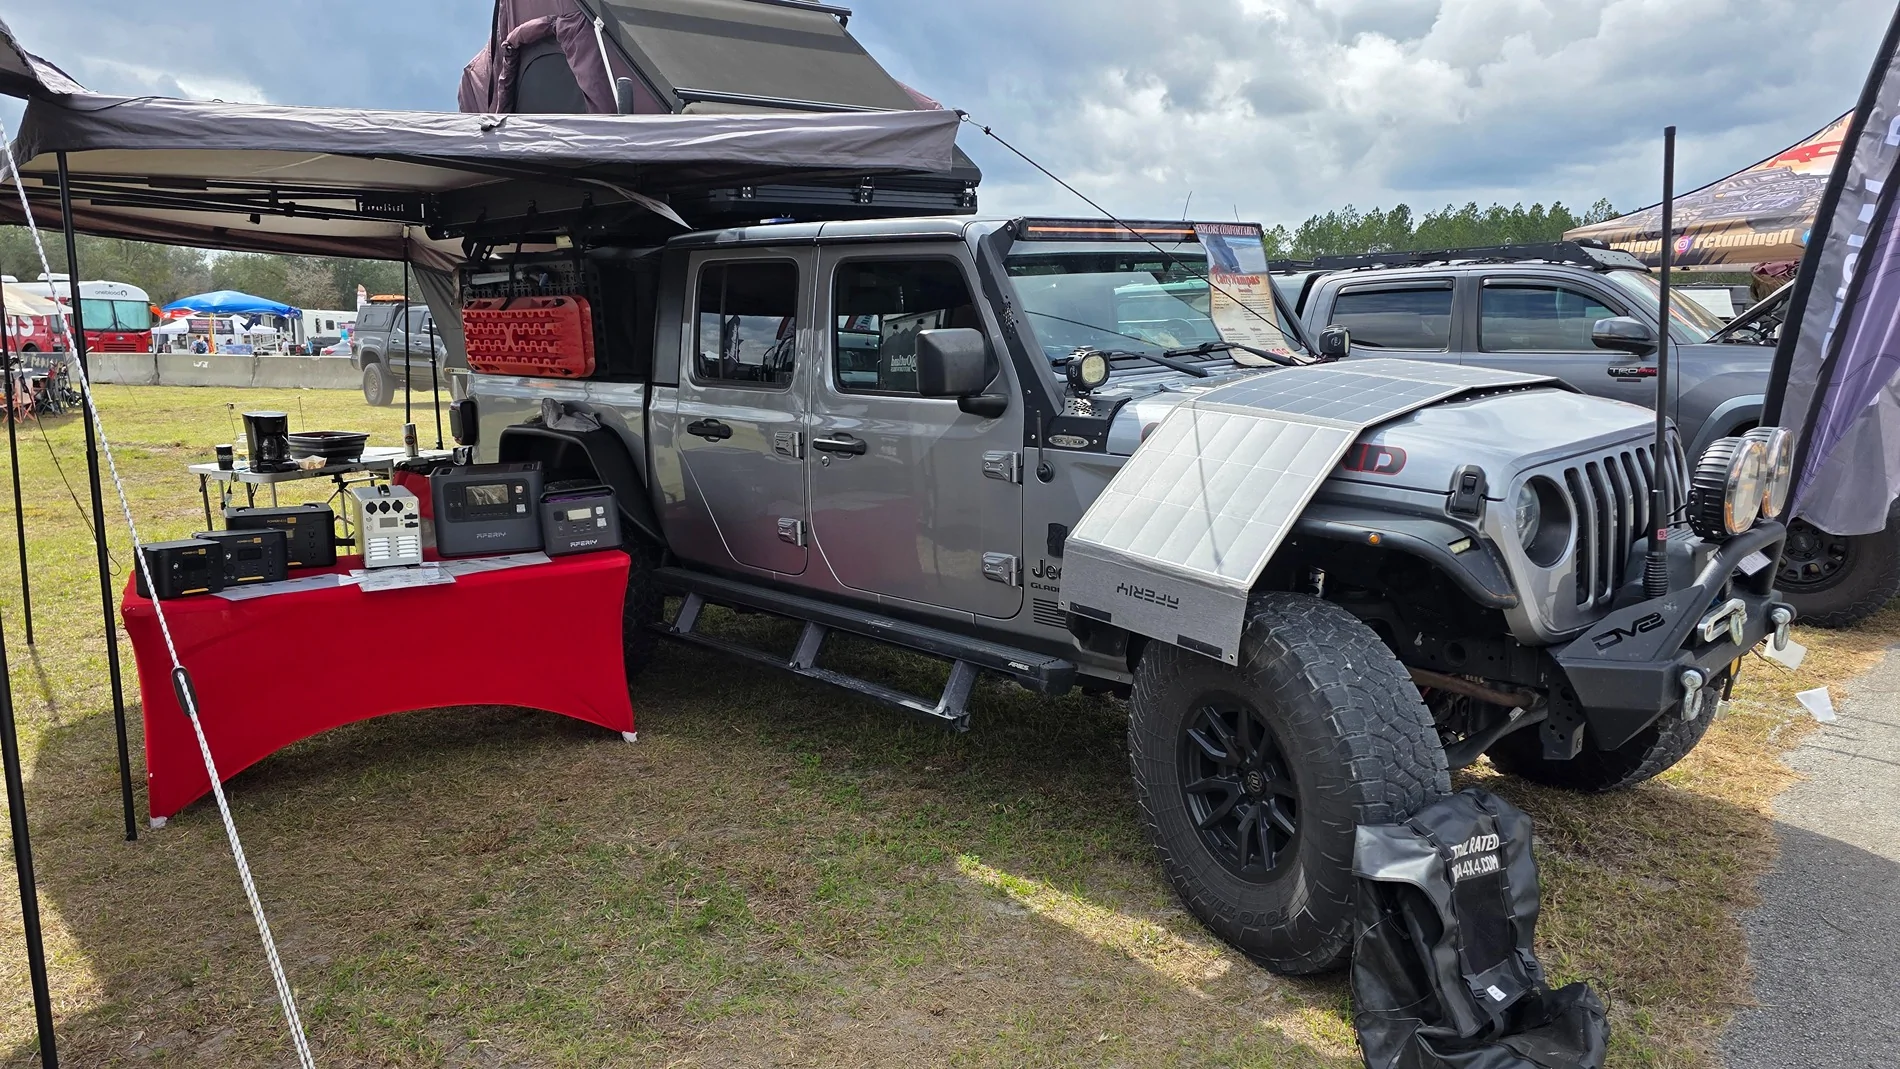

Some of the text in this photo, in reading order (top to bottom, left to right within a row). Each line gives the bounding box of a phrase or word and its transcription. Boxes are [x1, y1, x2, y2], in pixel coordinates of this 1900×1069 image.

[1197, 224, 1220, 235] EXPLORE
[1694, 229, 1795, 249] rctuningfl
[1031, 558, 1062, 580] Je
[1030, 582, 1060, 593] GLADI
[1469, 833, 1500, 854] RATED
